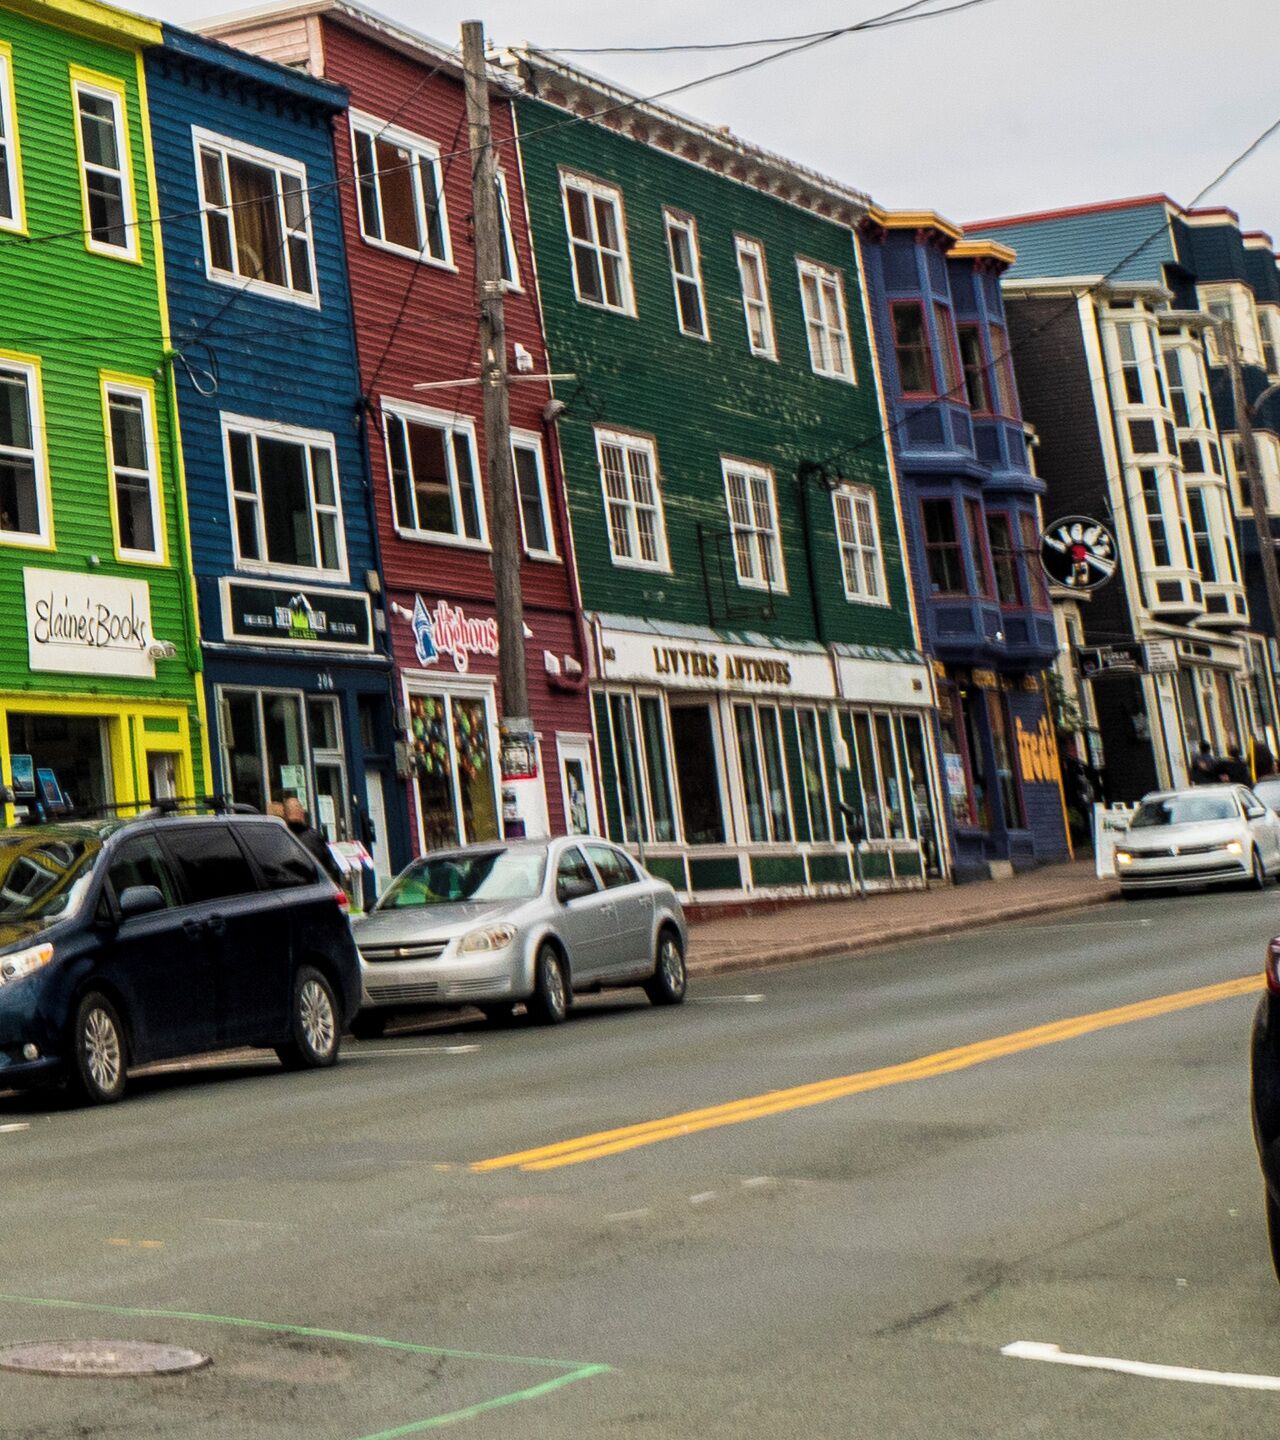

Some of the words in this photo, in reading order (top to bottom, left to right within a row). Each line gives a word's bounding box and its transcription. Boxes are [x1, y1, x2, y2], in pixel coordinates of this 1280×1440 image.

[34, 591, 95, 647] Elaine's
[96, 591, 147, 650] Books
[725, 655, 792, 685] ANTIQUES
